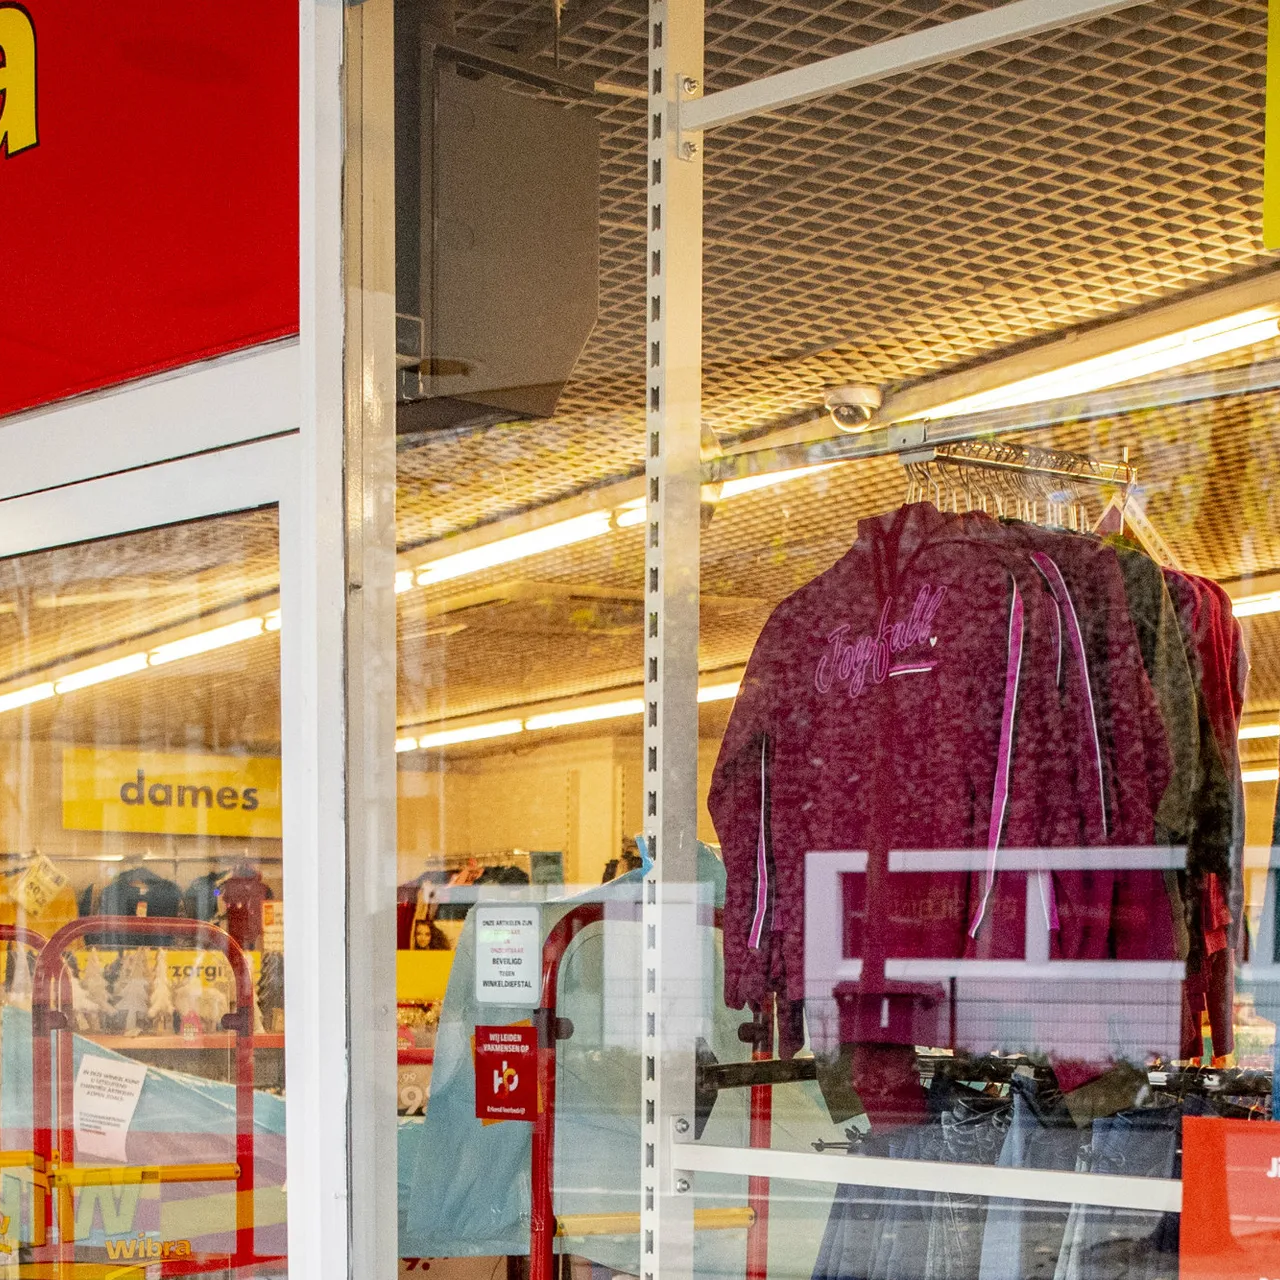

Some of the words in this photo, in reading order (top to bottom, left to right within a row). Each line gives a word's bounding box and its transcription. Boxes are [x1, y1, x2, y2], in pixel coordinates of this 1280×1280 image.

[120, 768, 259, 811] dames
[482, 980, 532, 989] WINKELDIEFSTAL
[489, 1033, 499, 1043] WIJ
[500, 1034, 522, 1042] LEIDEN
[483, 1044, 518, 1053] VAKMENSEN
[105, 1232, 192, 1259] Wibra
